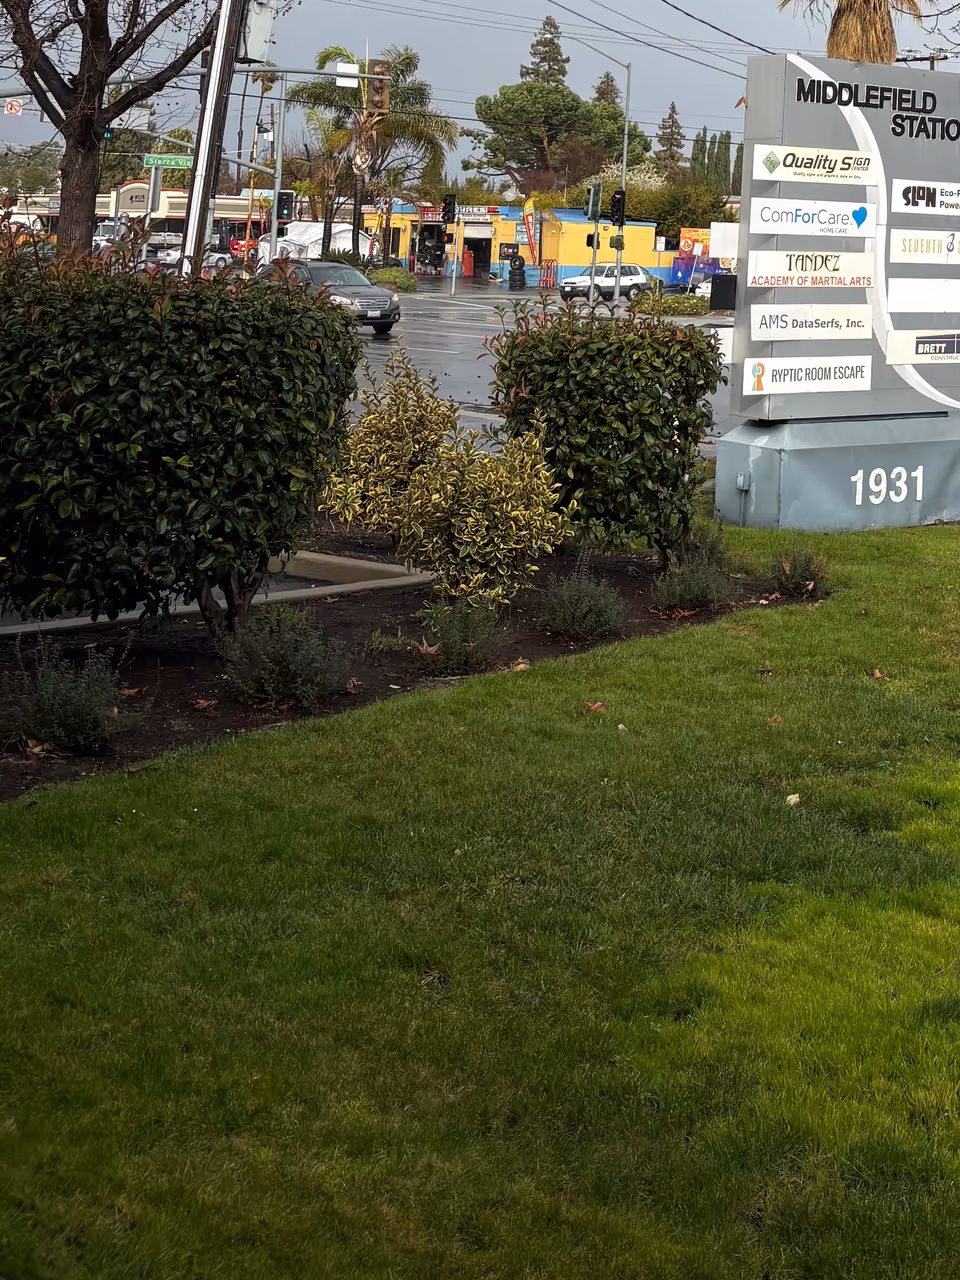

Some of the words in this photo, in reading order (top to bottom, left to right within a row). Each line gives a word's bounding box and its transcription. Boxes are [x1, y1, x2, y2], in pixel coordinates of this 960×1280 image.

[796, 77, 937, 114] MIDDLEFIELD
[148, 157, 176, 165] Sierra
[782, 152, 838, 174] Quality
[760, 206, 850, 225] ComForCare
[902, 237, 943, 254] SEVENTH
[785, 252, 841, 272] TANDEZ
[750, 275, 795, 286] ACADEMY
[796, 276, 810, 286] OF
[810, 276, 848, 286] MARTIAL
[849, 276, 872, 287] ARTS
[759, 314, 789, 330] AMS
[791, 318, 843, 330] DataSerfs,
[845, 318, 865, 329] Inc.
[917, 343, 947, 354] BRETT
[771, 367, 804, 383] RYPTIC
[804, 366, 832, 382] ROOM
[833, 365, 866, 381] ESCAPE
[850, 464, 924, 506] 1931
